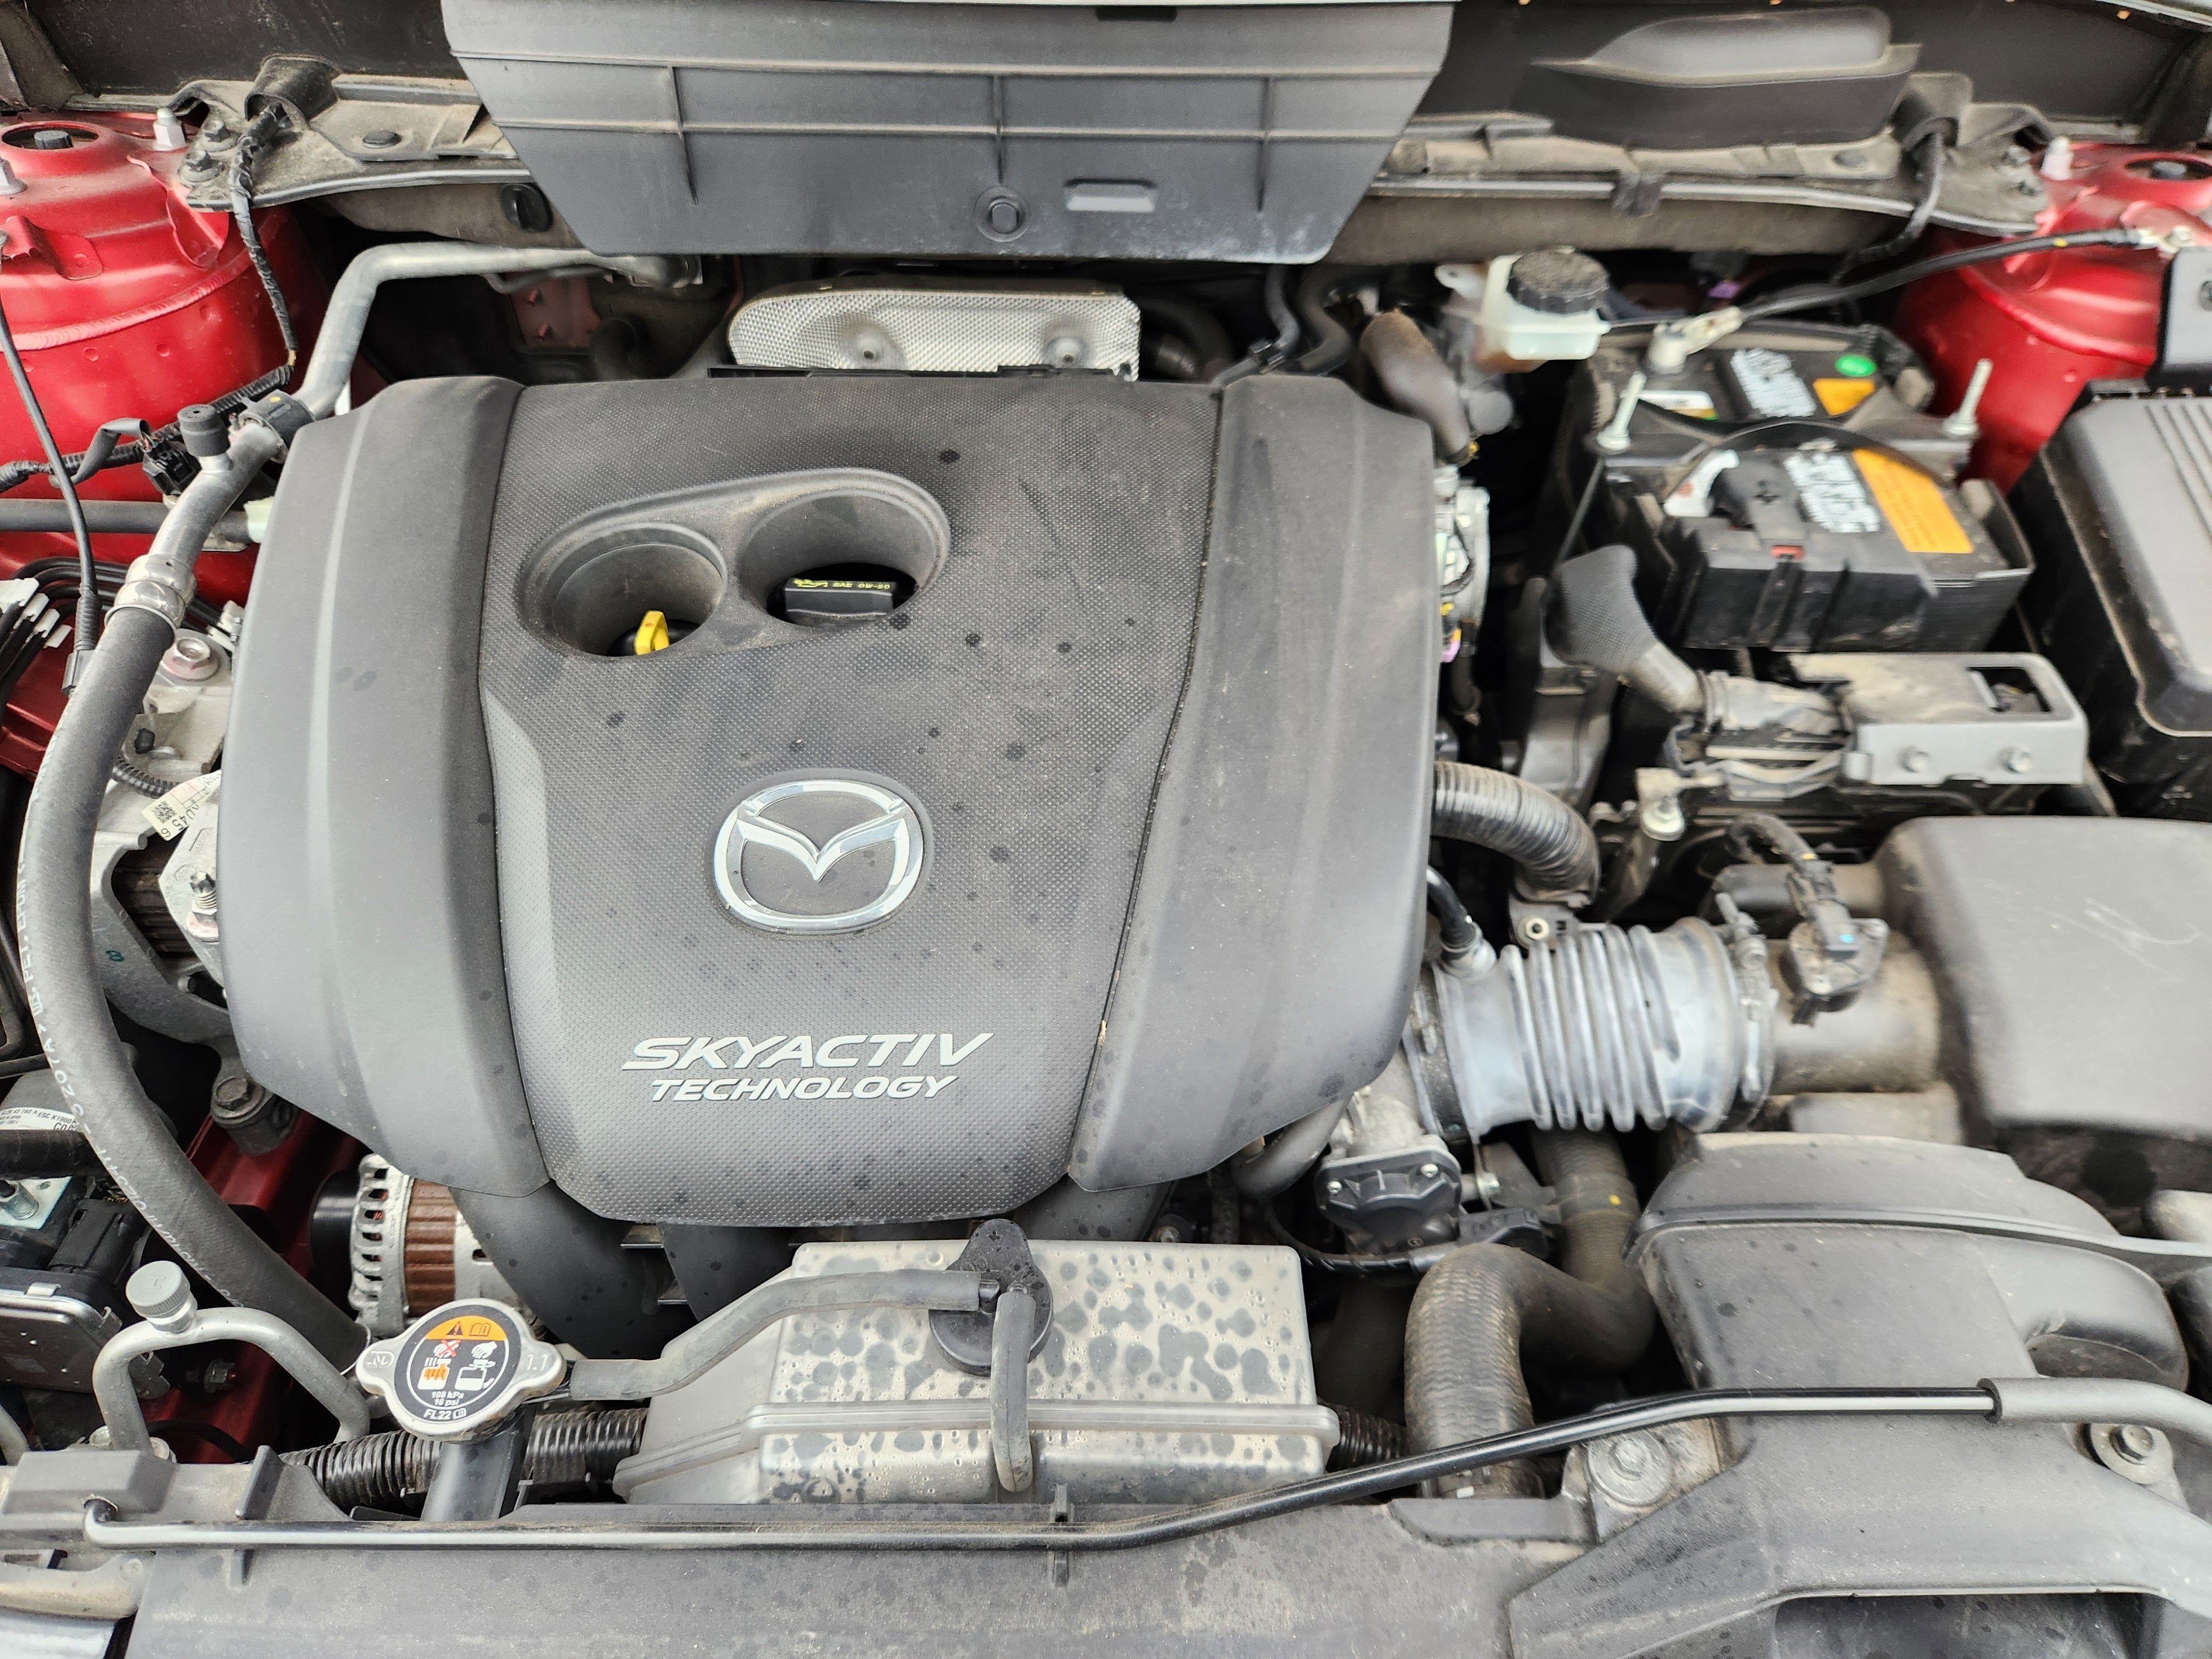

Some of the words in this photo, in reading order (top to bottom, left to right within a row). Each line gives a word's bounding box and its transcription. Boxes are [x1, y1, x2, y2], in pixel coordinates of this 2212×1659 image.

[621, 1033, 995, 1071] SKYACTIV
[651, 1076, 959, 1102] TECHNOLOGY
[424, 1408, 452, 1420] FL22
